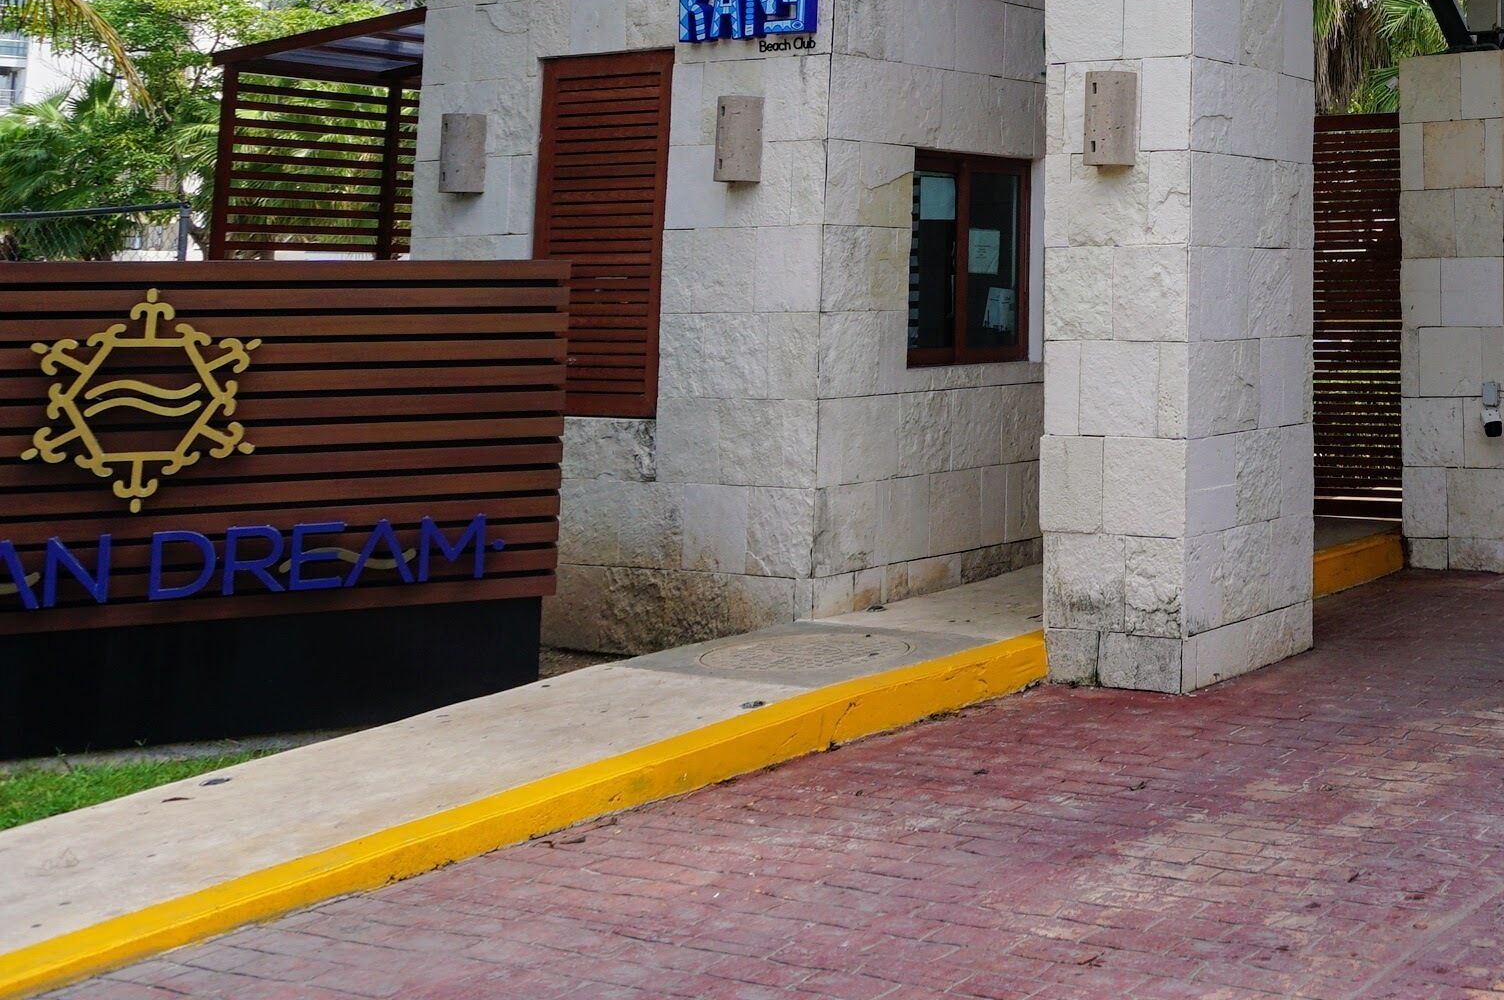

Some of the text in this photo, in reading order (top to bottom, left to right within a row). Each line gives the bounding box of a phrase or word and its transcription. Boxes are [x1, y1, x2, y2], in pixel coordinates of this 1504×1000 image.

[759, 37, 816, 53] Beach Club
[148, 513, 487, 600] DREAM
